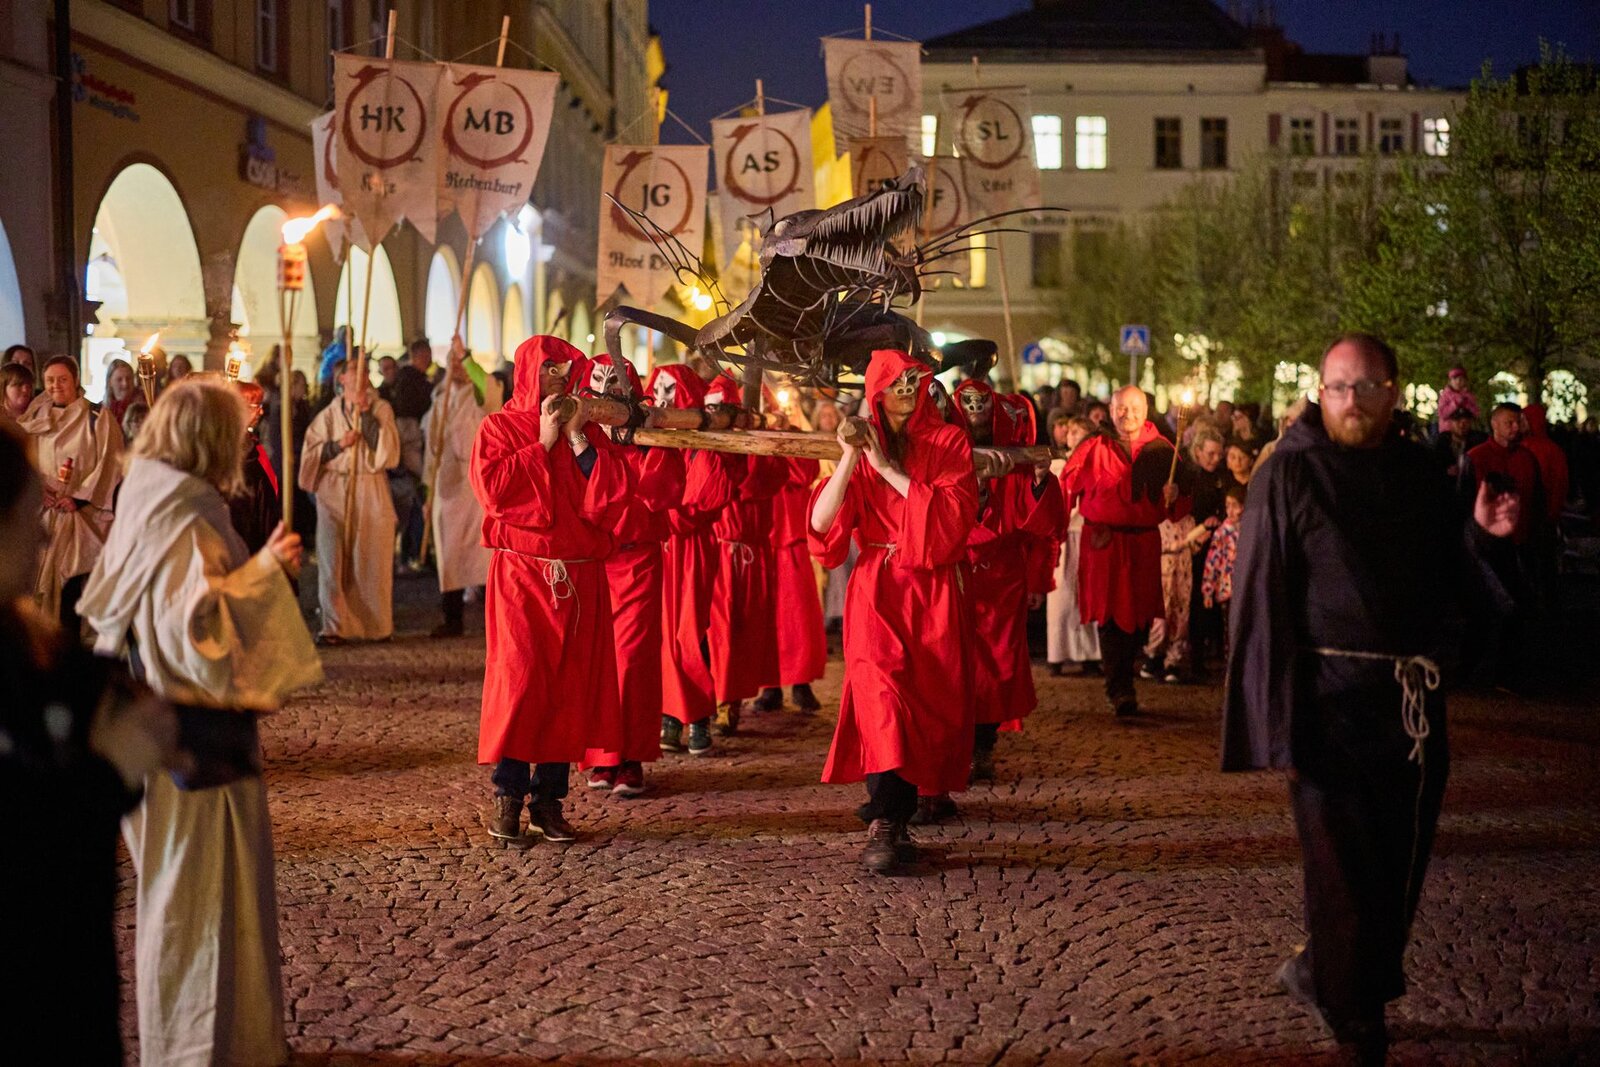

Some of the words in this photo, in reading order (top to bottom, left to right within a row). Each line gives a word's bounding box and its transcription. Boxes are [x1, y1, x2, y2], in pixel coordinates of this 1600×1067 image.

[360, 104, 406, 133] HK
[464, 107, 515, 135] MB
[977, 121, 1009, 141] SL
[742, 151, 780, 174] AS
[641, 184, 672, 214] JG
